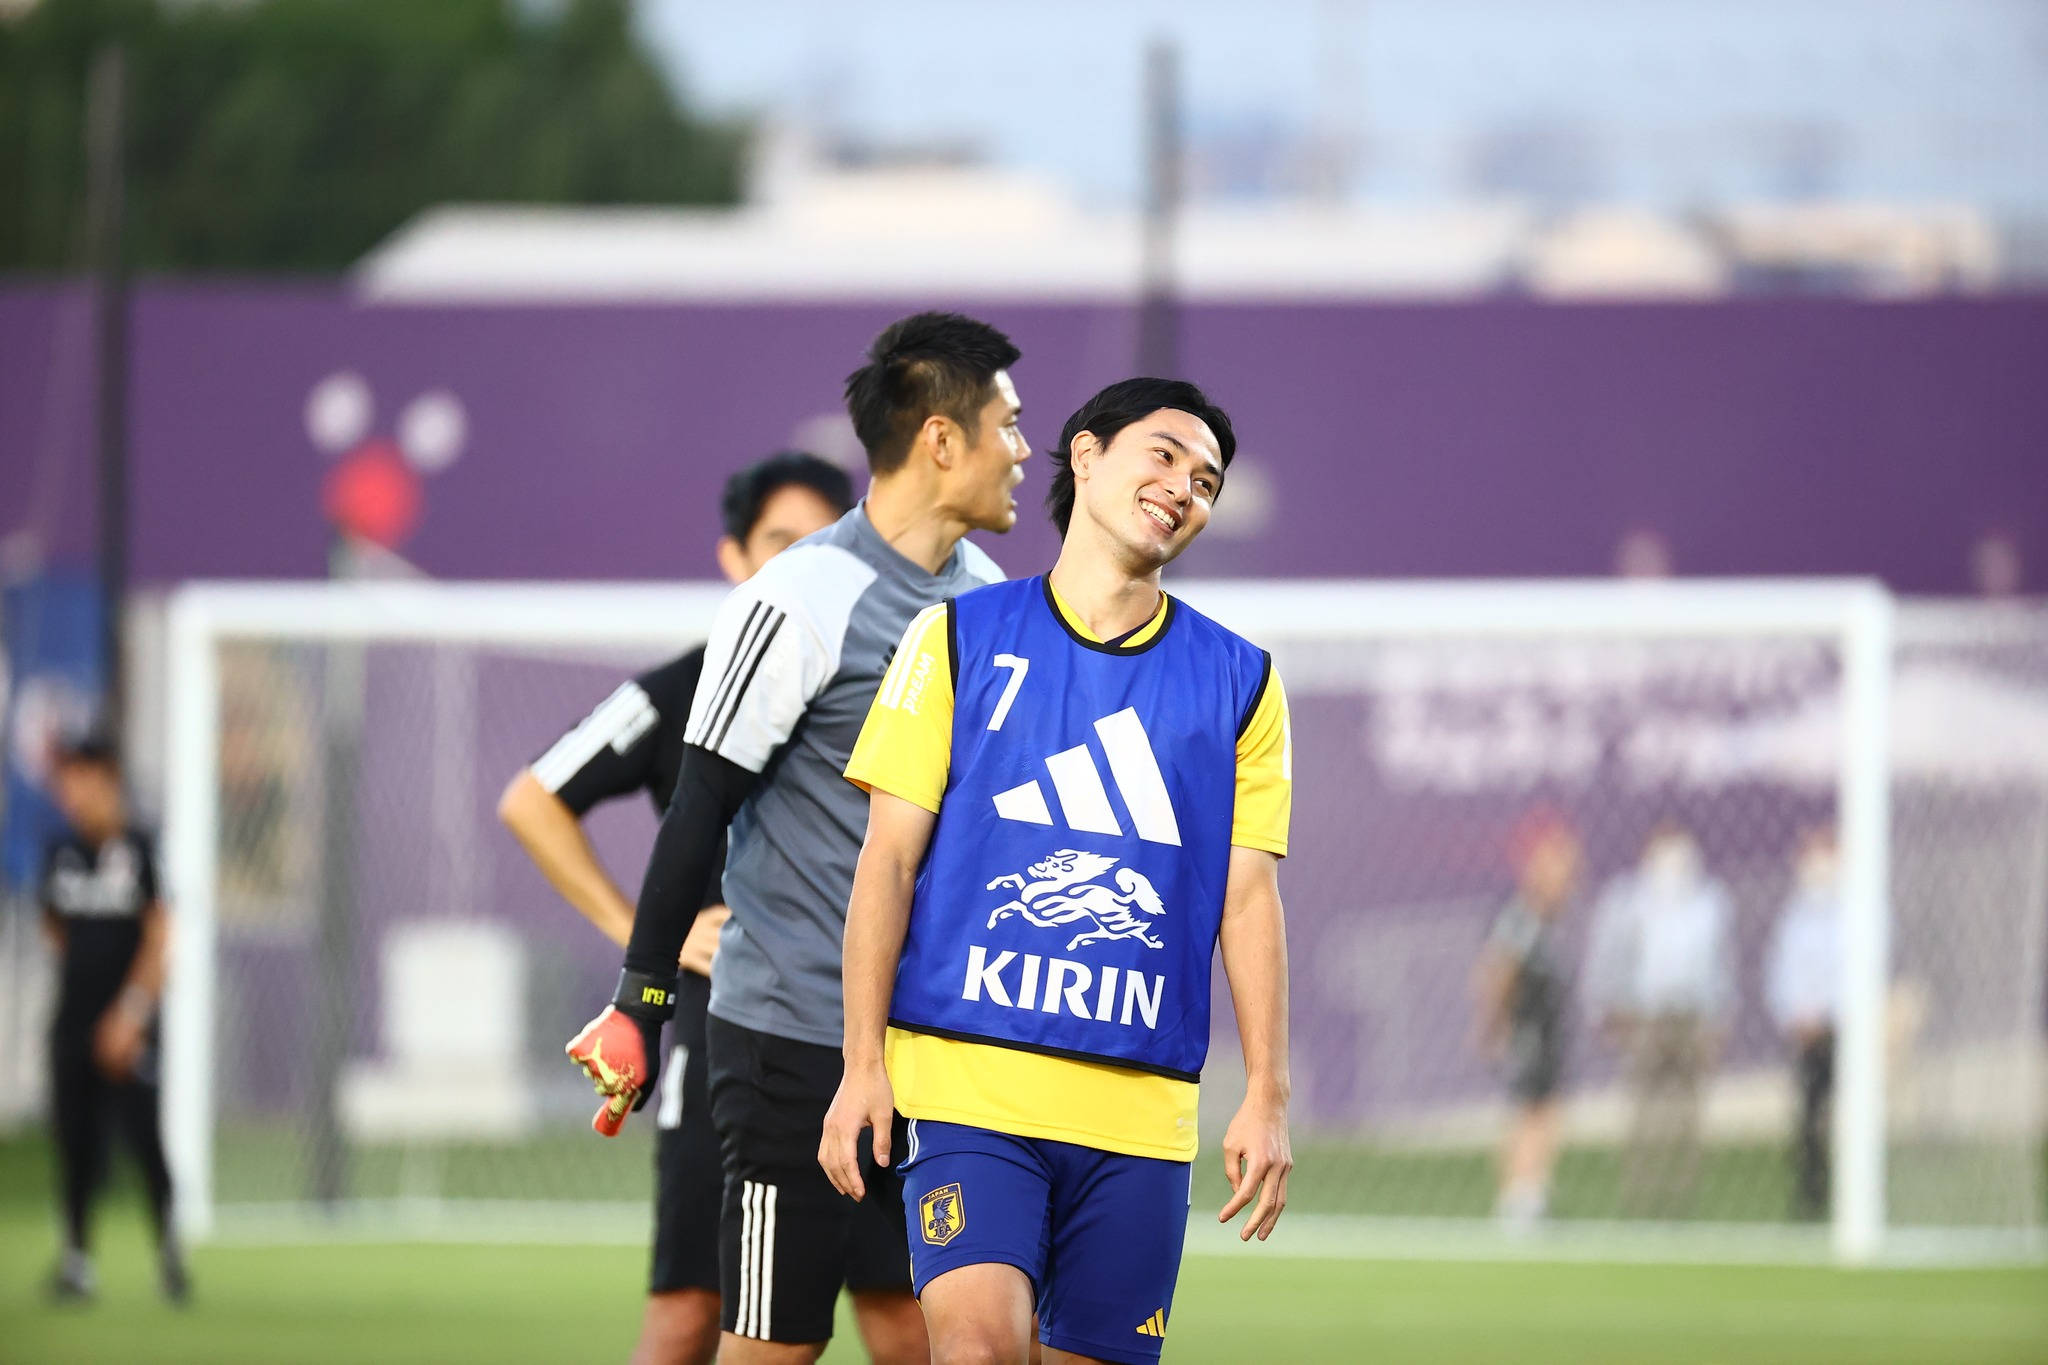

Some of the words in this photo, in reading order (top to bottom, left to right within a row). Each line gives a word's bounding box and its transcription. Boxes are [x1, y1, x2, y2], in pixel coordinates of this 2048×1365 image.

[902, 652, 936, 715] DREAM
[987, 653, 1030, 732] 7
[961, 945, 1165, 1030] KIRIN
[928, 1188, 949, 1200] JAPAN
[933, 1224, 952, 1238] JFA
